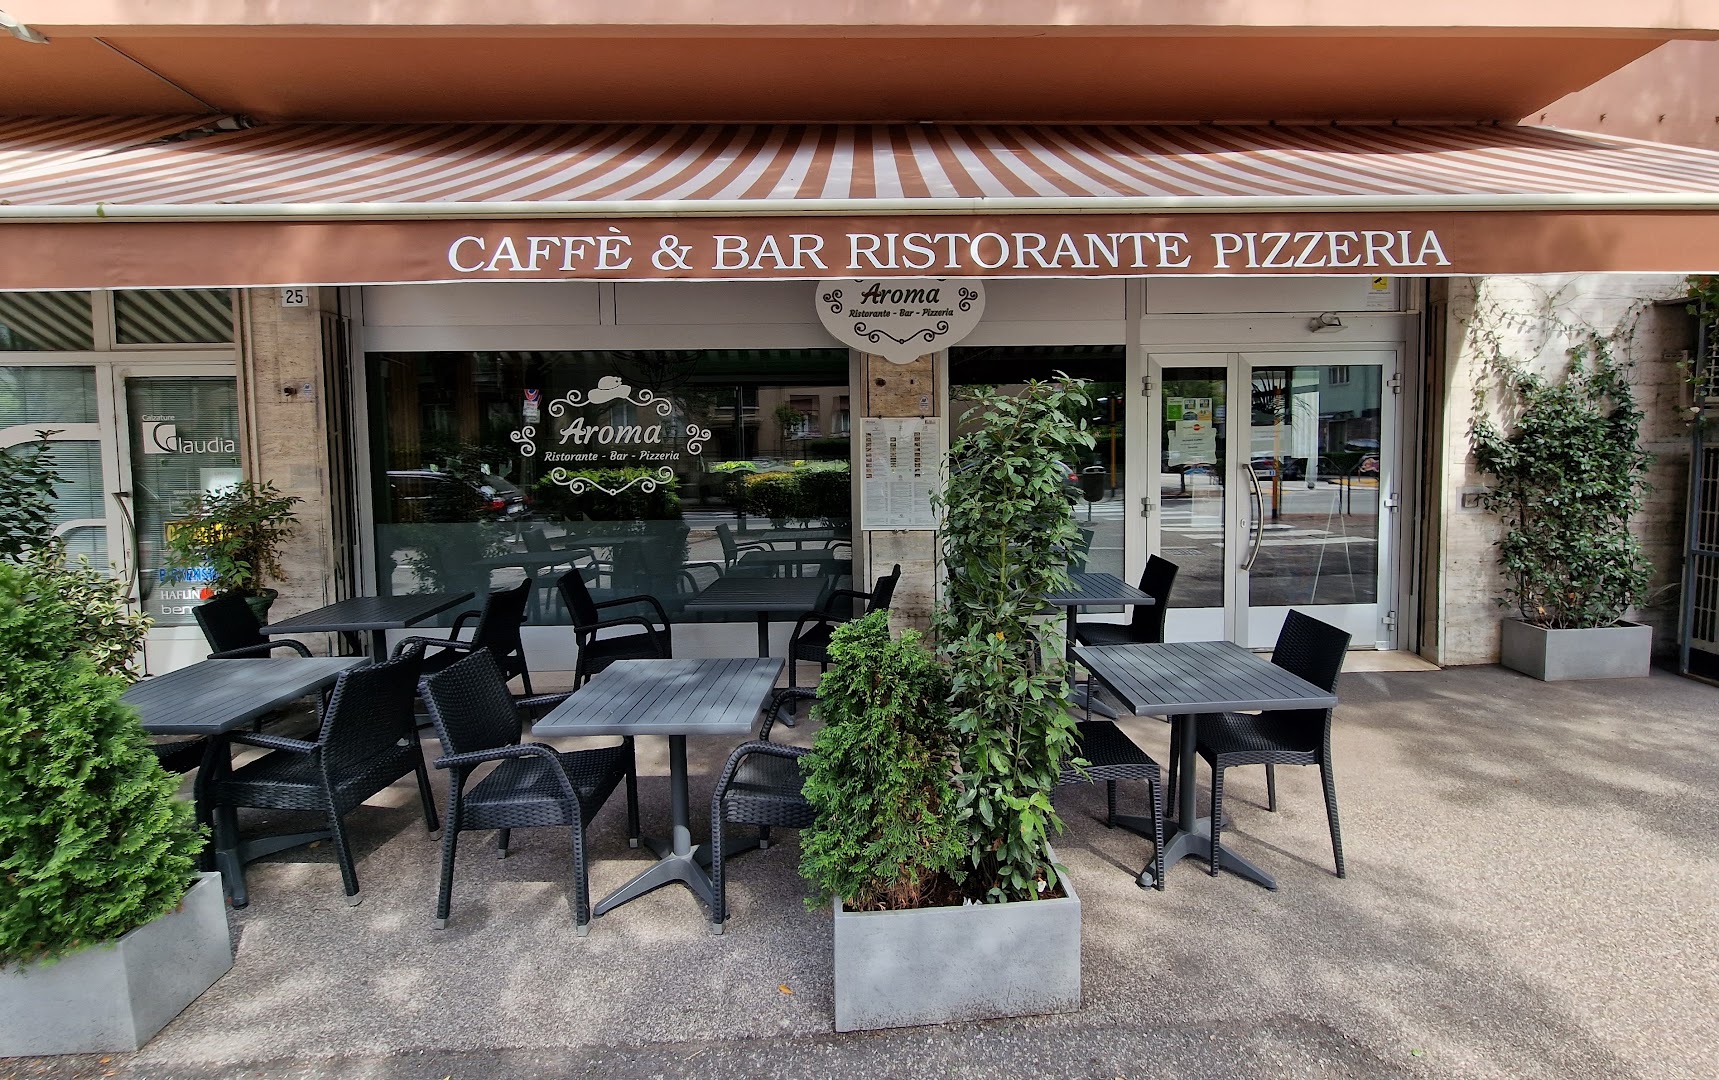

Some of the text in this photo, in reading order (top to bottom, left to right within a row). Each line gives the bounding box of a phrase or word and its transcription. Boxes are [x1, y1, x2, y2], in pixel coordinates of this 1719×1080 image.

[448, 227, 1452, 274] CAFFÈ & BAR RISTORANTE PIZZERIA
[285, 289, 304, 304] 25
[860, 282, 941, 305] Aroma
[848, 308, 891, 318] Ristorante
[899, 308, 914, 318] Bar
[921, 307, 954, 317] Pizzeria
[141, 414, 176, 422] Calzature
[558, 417, 662, 445] Aroma
[544, 451, 598, 462] Ristorante
[609, 450, 629, 461] Bar
[638, 450, 680, 461] Pizzeria
